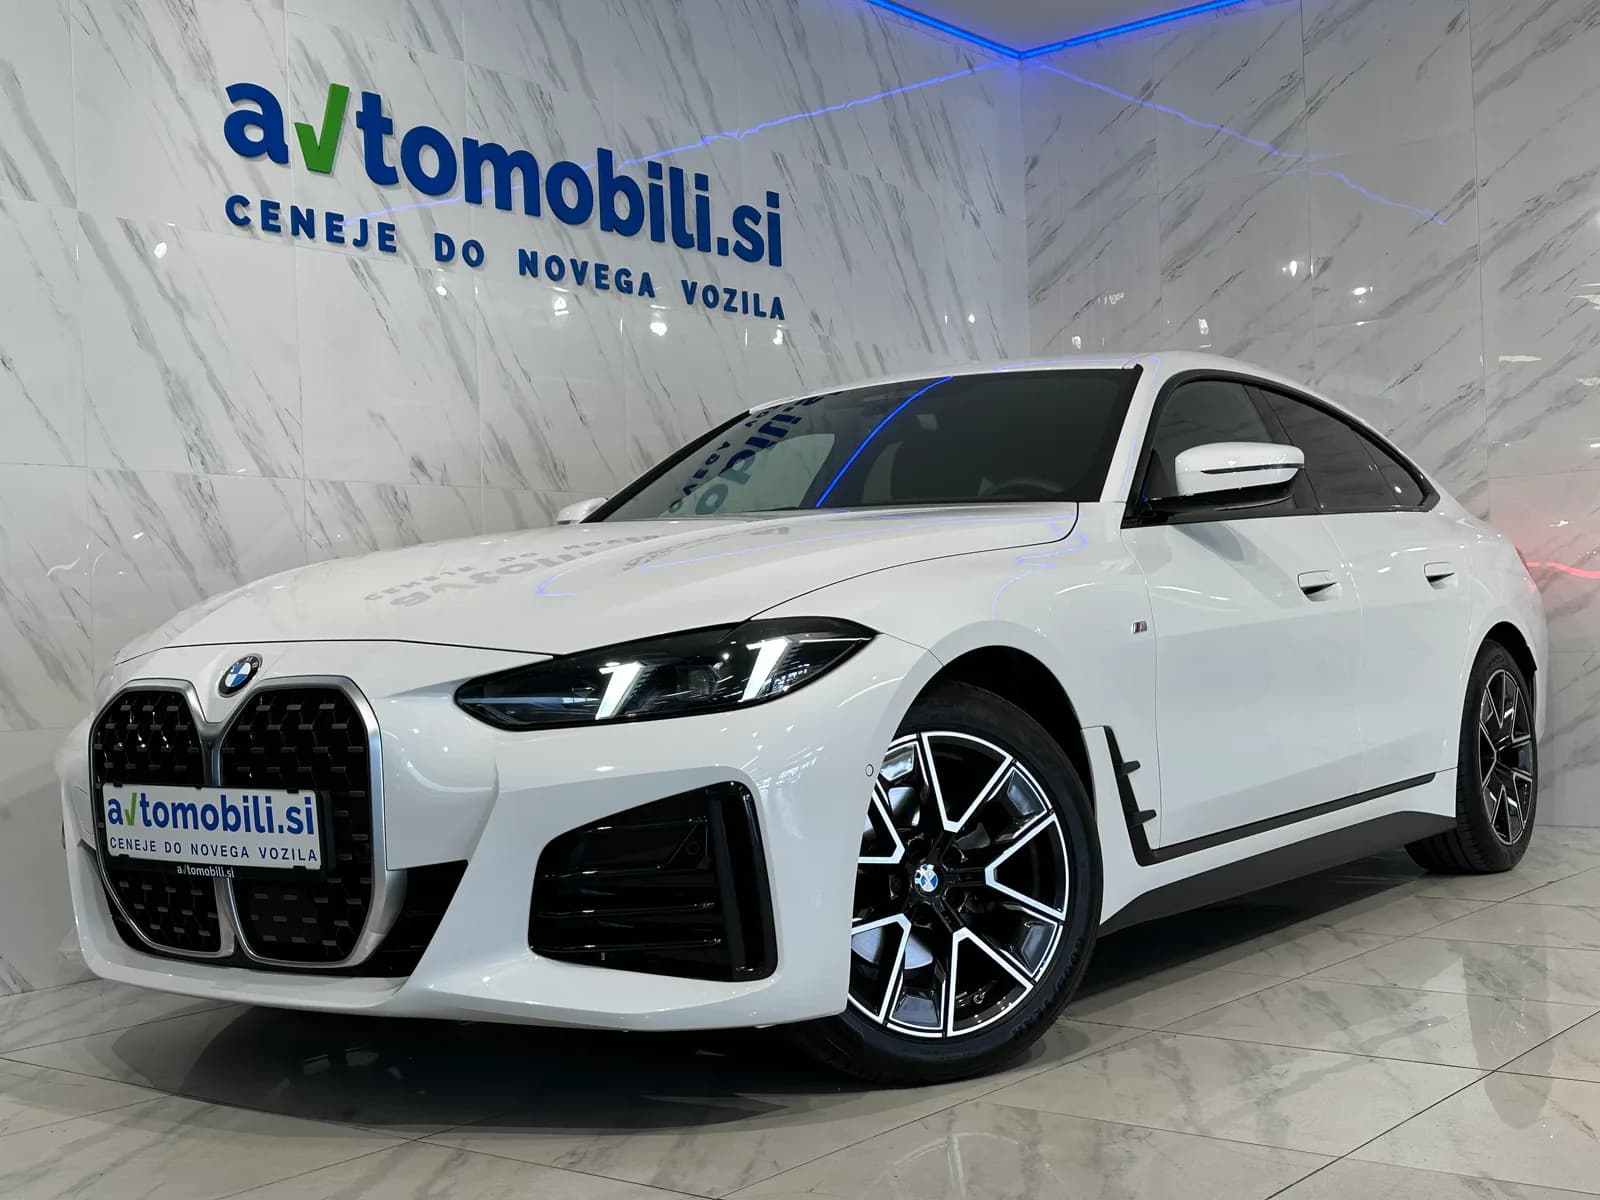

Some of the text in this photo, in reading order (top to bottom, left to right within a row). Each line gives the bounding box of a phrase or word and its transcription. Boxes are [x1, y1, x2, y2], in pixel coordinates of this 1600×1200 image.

[224, 194, 785, 321] CENEJE DO NOVEGA VOZILA
[110, 836, 318, 862] CENEJE DO NOVEGA VOZILA
